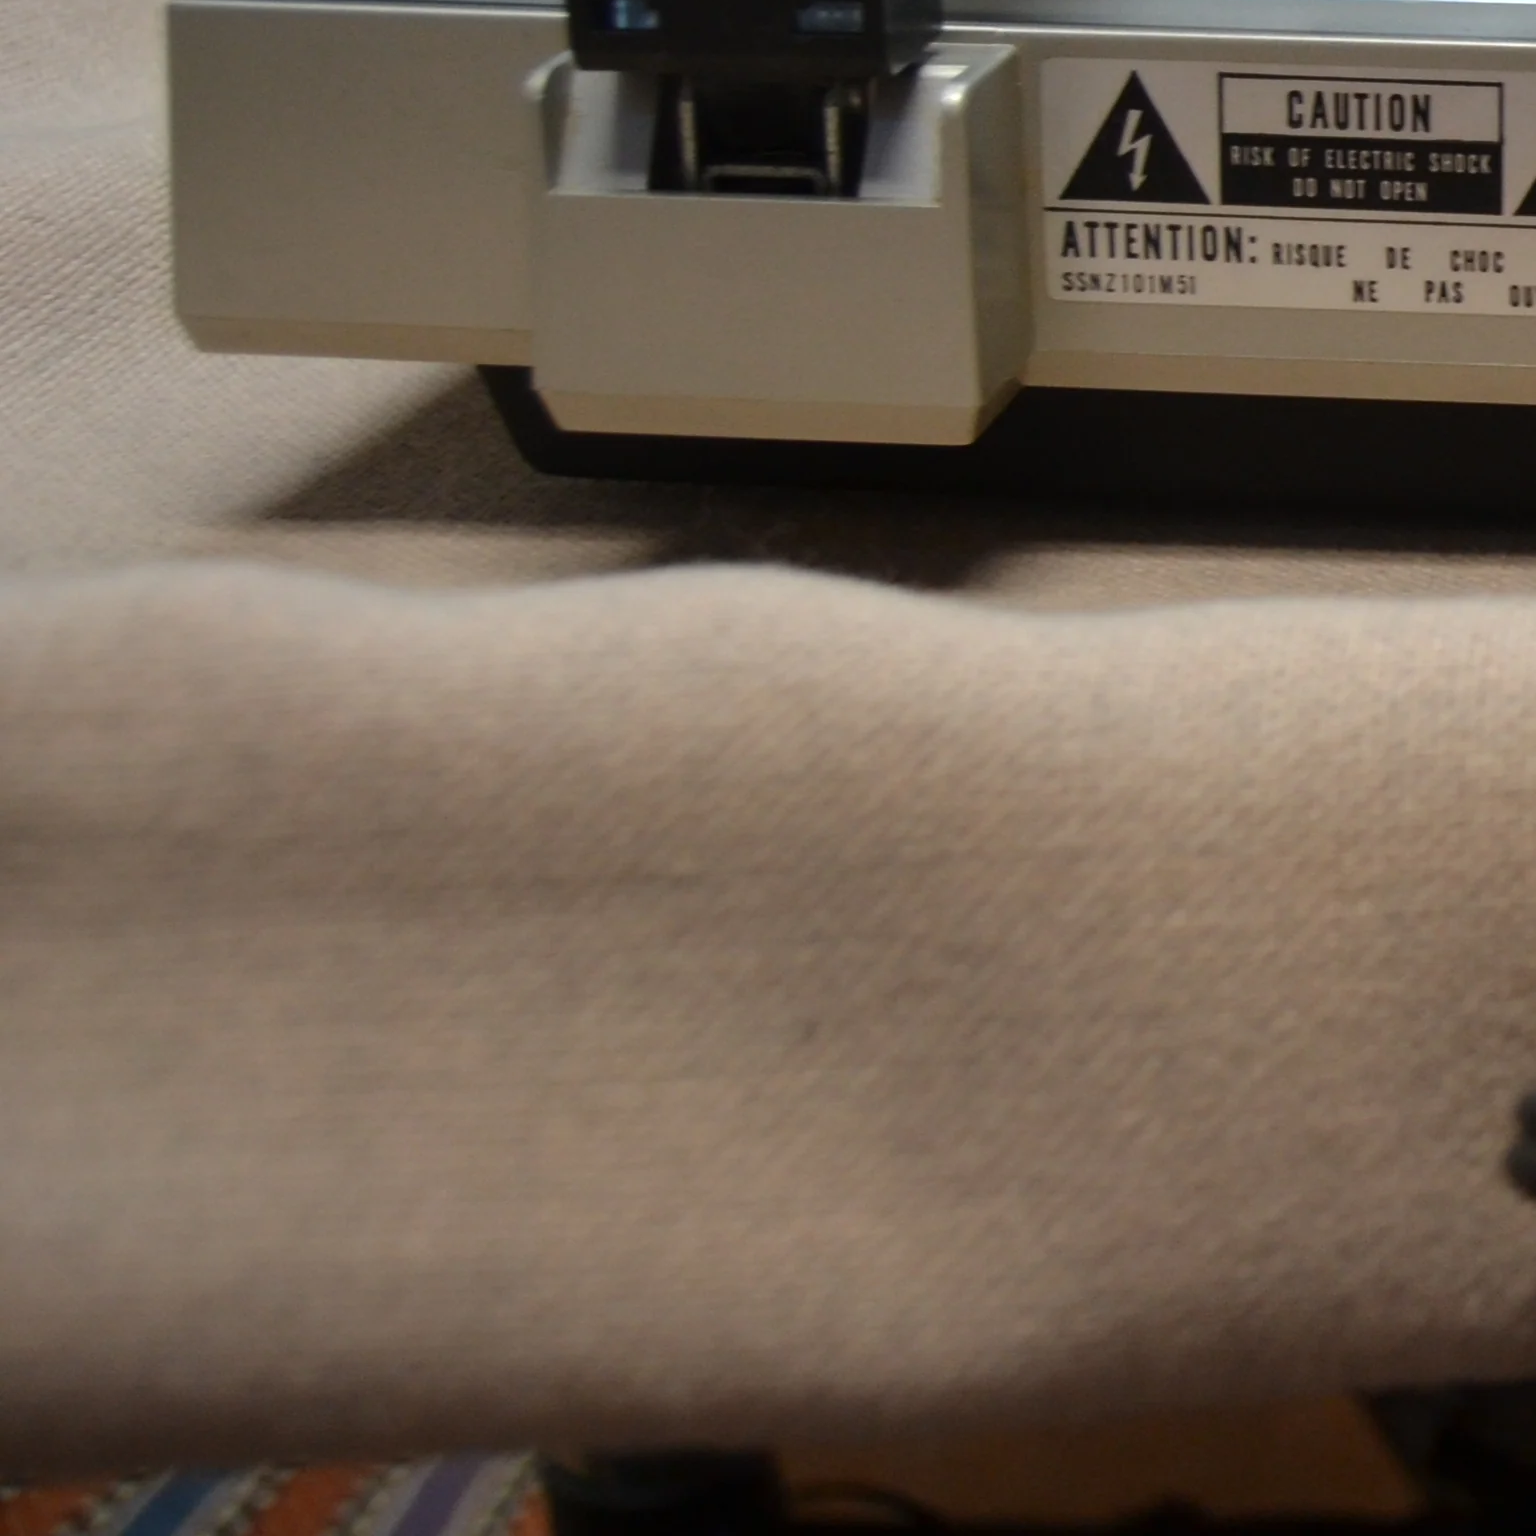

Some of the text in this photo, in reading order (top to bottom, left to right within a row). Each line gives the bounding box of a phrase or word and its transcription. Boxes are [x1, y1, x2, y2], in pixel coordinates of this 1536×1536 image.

[1286, 89, 1433, 134] CAUTION
[1230, 145, 1492, 174] RISK OF ELECTRIC SHOCK
[1292, 176, 1428, 202] DO NOT OPEN
[1060, 220, 1258, 264] ATTENTION:
[1271, 241, 1348, 269] RISQUE
[1386, 246, 1413, 270] DE
[1450, 248, 1506, 276] CHOC
[1353, 279, 1379, 304] NE
[1424, 280, 1466, 306] PAS
